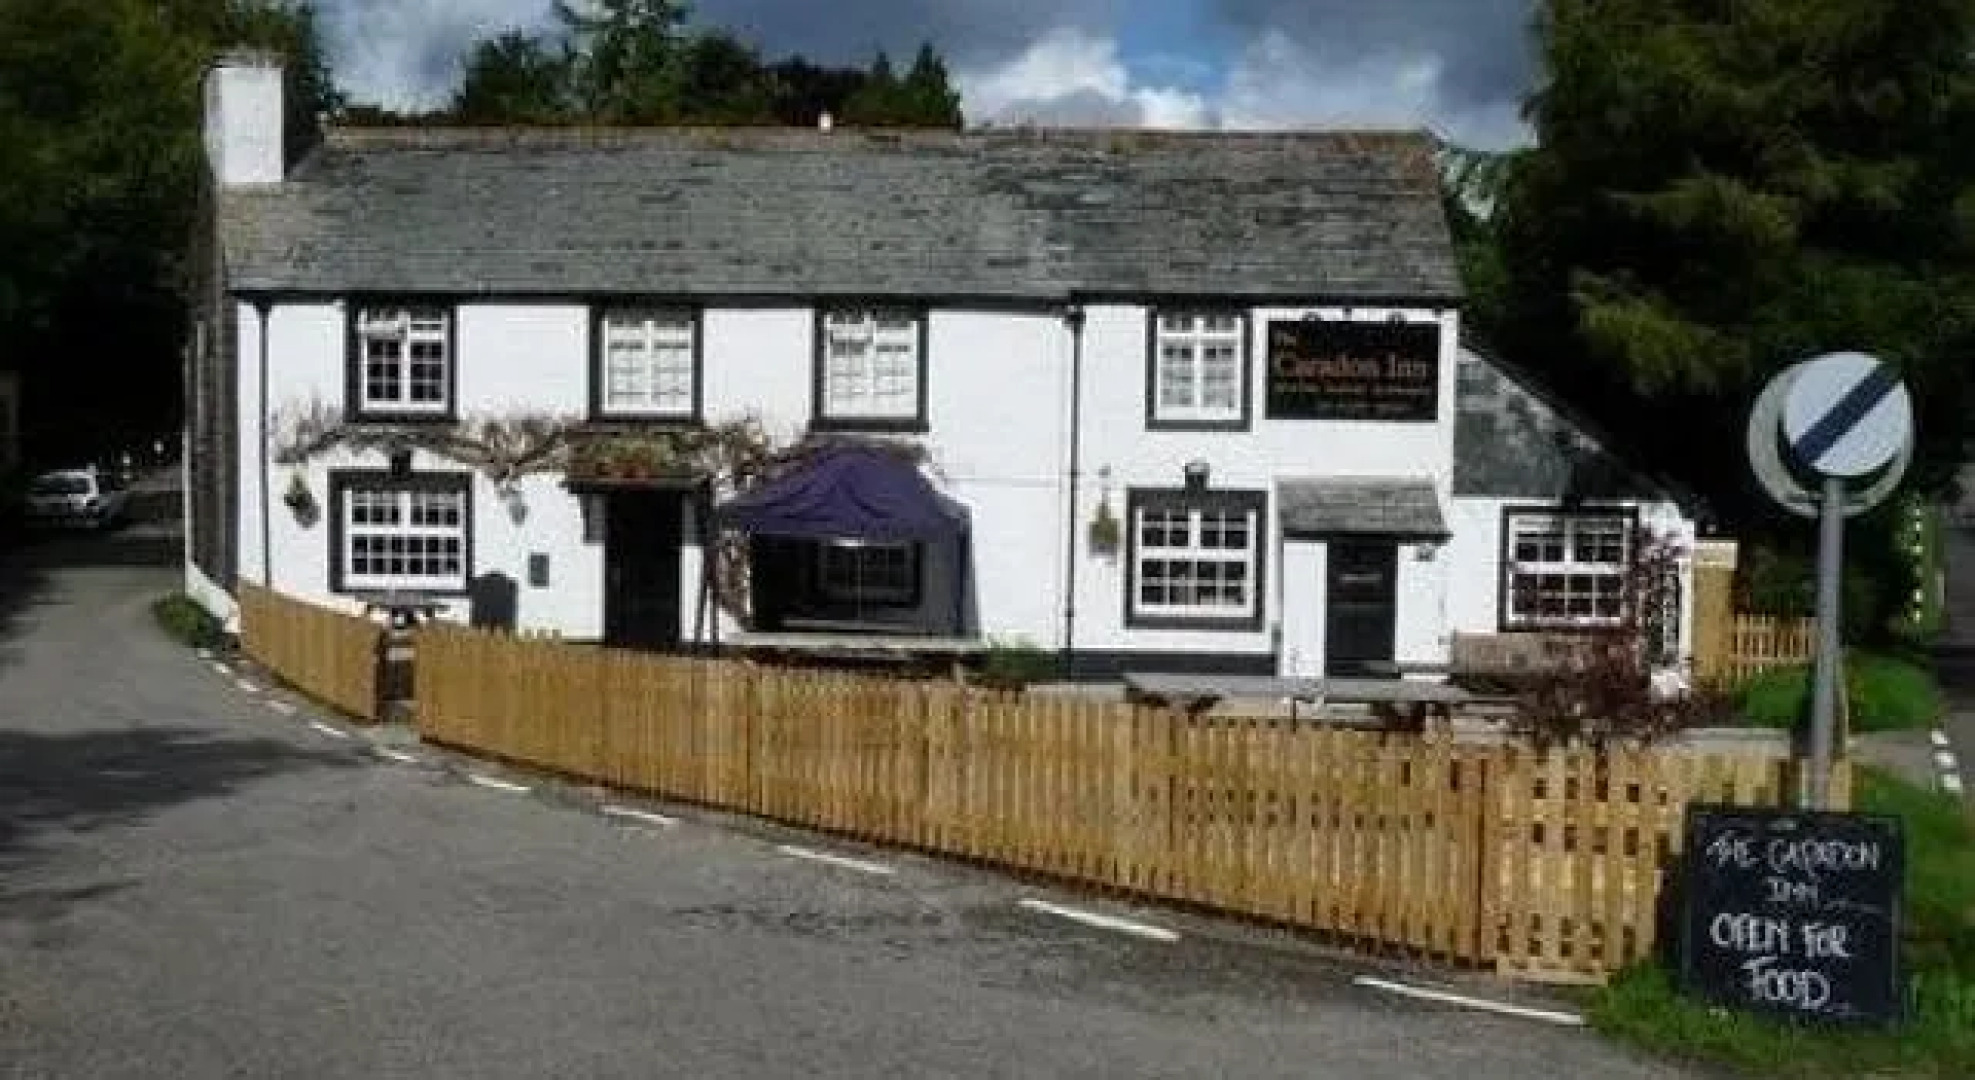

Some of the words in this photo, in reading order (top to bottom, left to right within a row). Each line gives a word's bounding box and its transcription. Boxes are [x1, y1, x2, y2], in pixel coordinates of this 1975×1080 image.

[1388, 352, 1429, 379] Inn
[1710, 912, 1791, 952] OPEN
[1802, 922, 1853, 958] FOR
[1740, 955, 1832, 1010] FOOD
